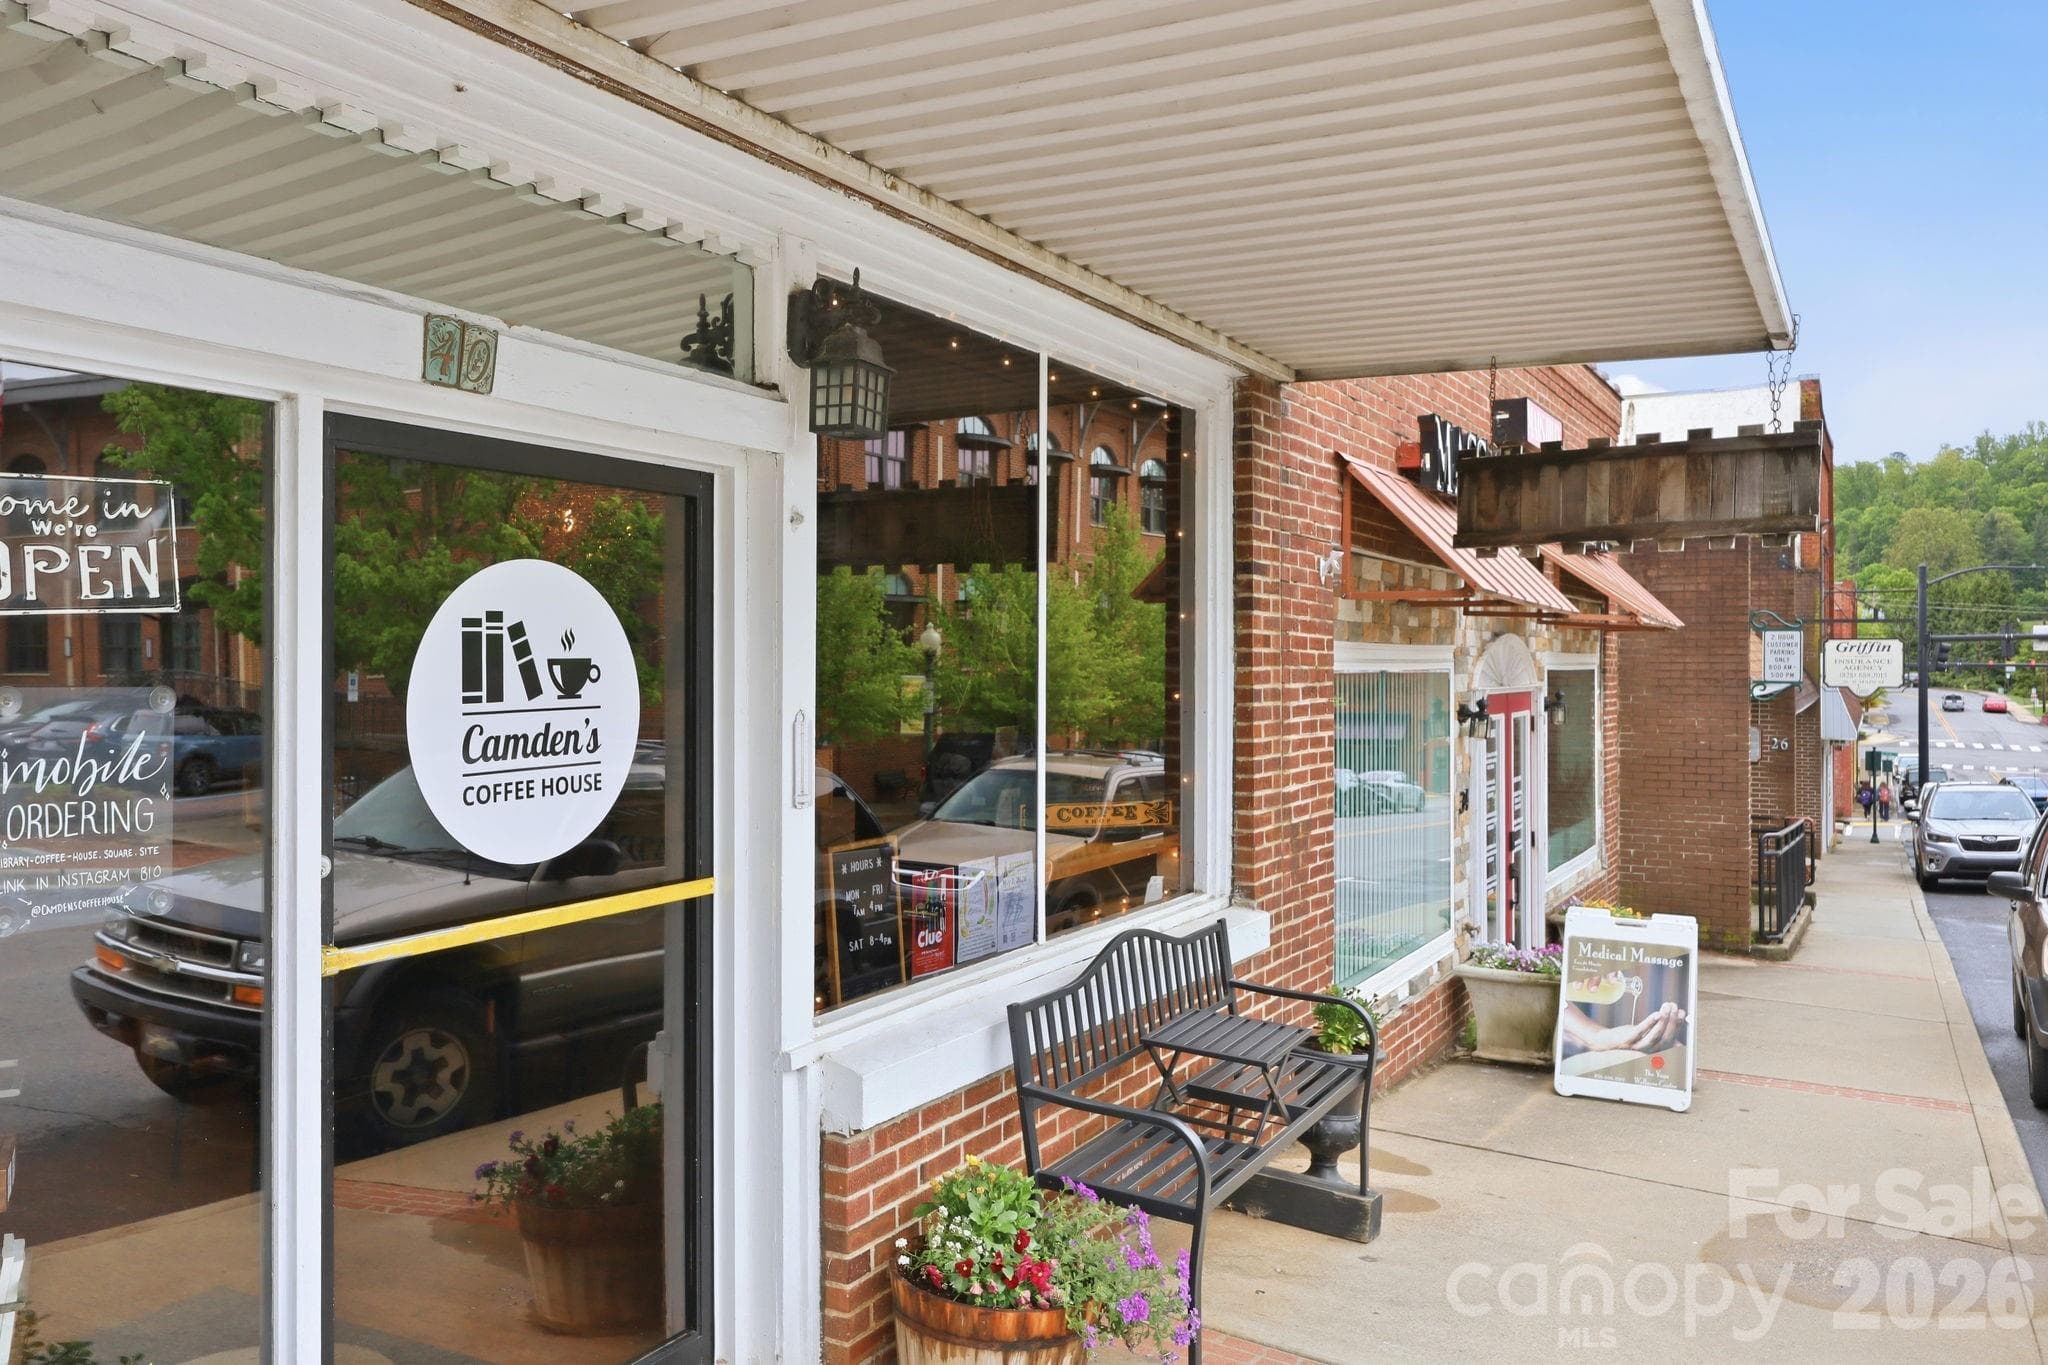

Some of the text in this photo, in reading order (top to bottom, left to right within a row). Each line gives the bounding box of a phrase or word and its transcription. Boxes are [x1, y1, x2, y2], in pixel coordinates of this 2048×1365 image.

[0, 490, 153, 520] ome in
[1836, 642, 1891, 655] Griffin
[461, 717, 602, 765] Camden's
[1771, 737, 1789, 750] 26
[2, 729, 167, 797] mobile
[462, 773, 602, 807] COFFEE HOUSE
[6, 797, 154, 842] ORDERING
[1056, 805, 1138, 823] COFFEE
[36, 876, 49, 890] IN
[57, 869, 131, 887] INSTAGRAM
[140, 865, 162, 881] BIO
[850, 861, 874, 873] HOURS
[845, 889, 860, 902] MON
[872, 884, 884, 897] FRI
[848, 939, 864, 952] SAT
[917, 929, 943, 949] Clue
[1578, 942, 1684, 968] Medical Massage
